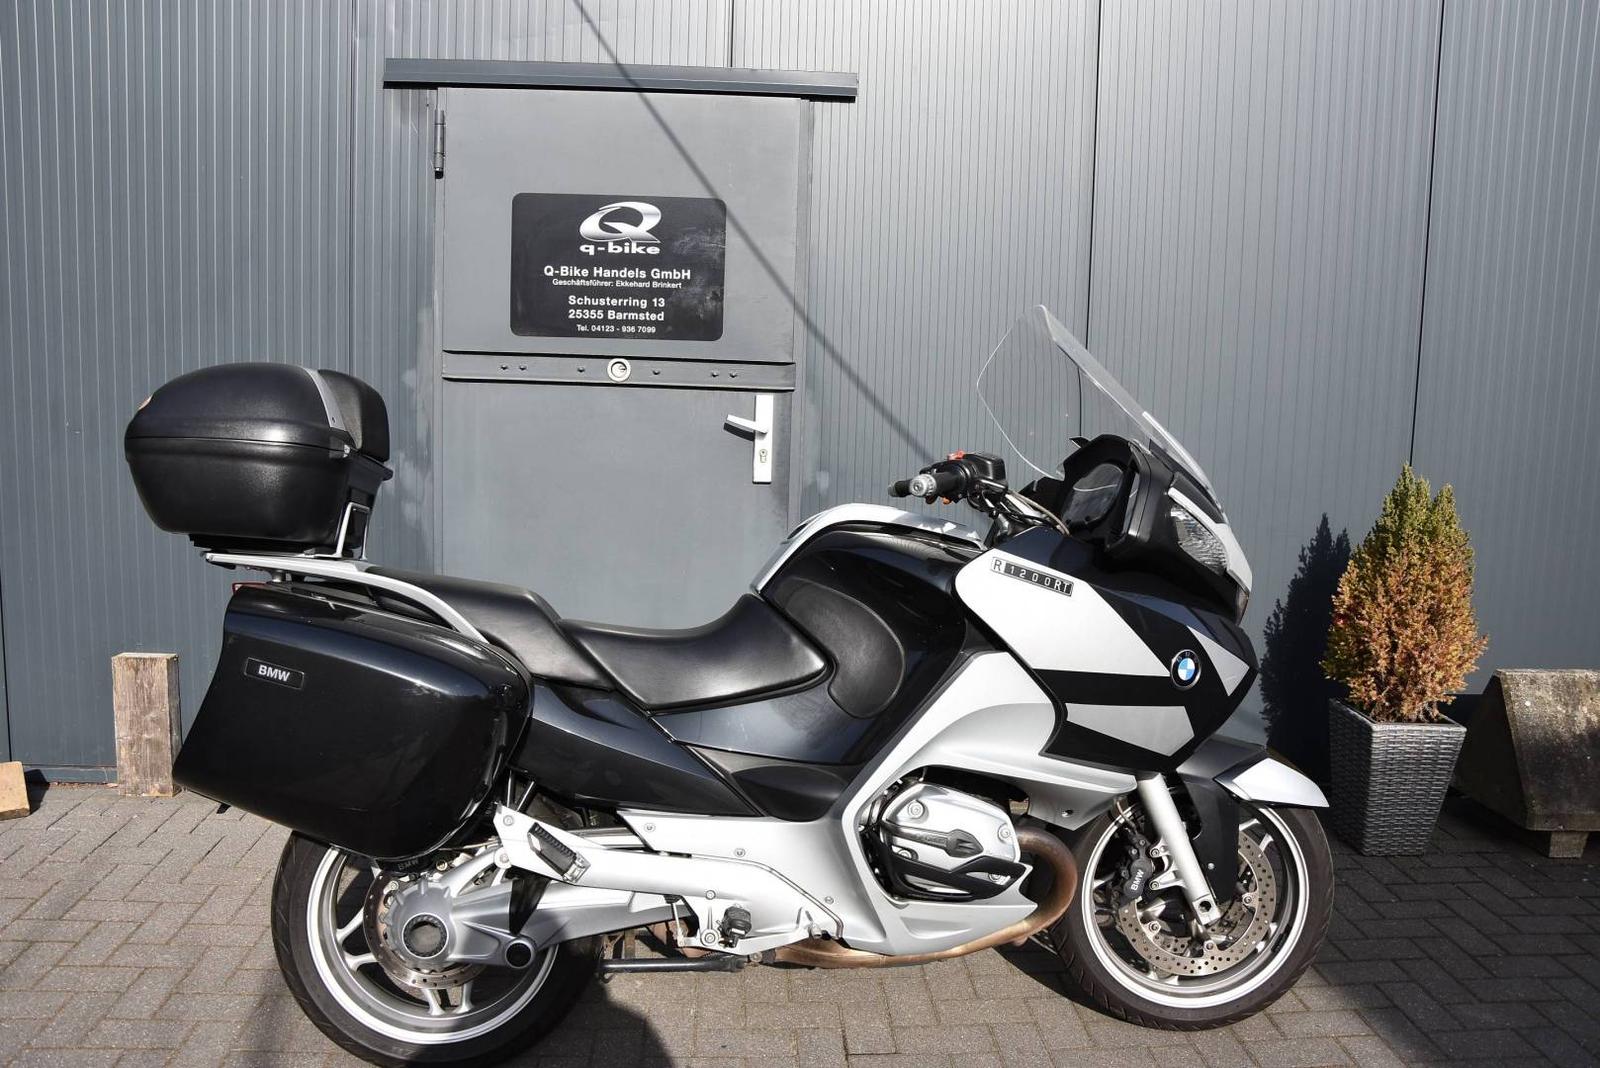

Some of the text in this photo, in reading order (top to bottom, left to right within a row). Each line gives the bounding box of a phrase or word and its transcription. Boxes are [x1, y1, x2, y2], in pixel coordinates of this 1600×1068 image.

[580, 242, 661, 255] q-bike
[544, 265, 691, 280] Q-Bike Handels GmbH
[552, 279, 614, 287] Geschäftsführer:
[652, 281, 682, 289] Brinkert
[568, 295, 665, 308] Schusterring 13
[568, 310, 665, 321] 25355 Barmsted
[577, 324, 589, 332] Tel.
[591, 324, 615, 332] 04123
[622, 325, 636, 333] 936
[993, 559, 1002, 571] R
[258, 664, 290, 681] BMW
[1131, 869, 1144, 890] BMW
